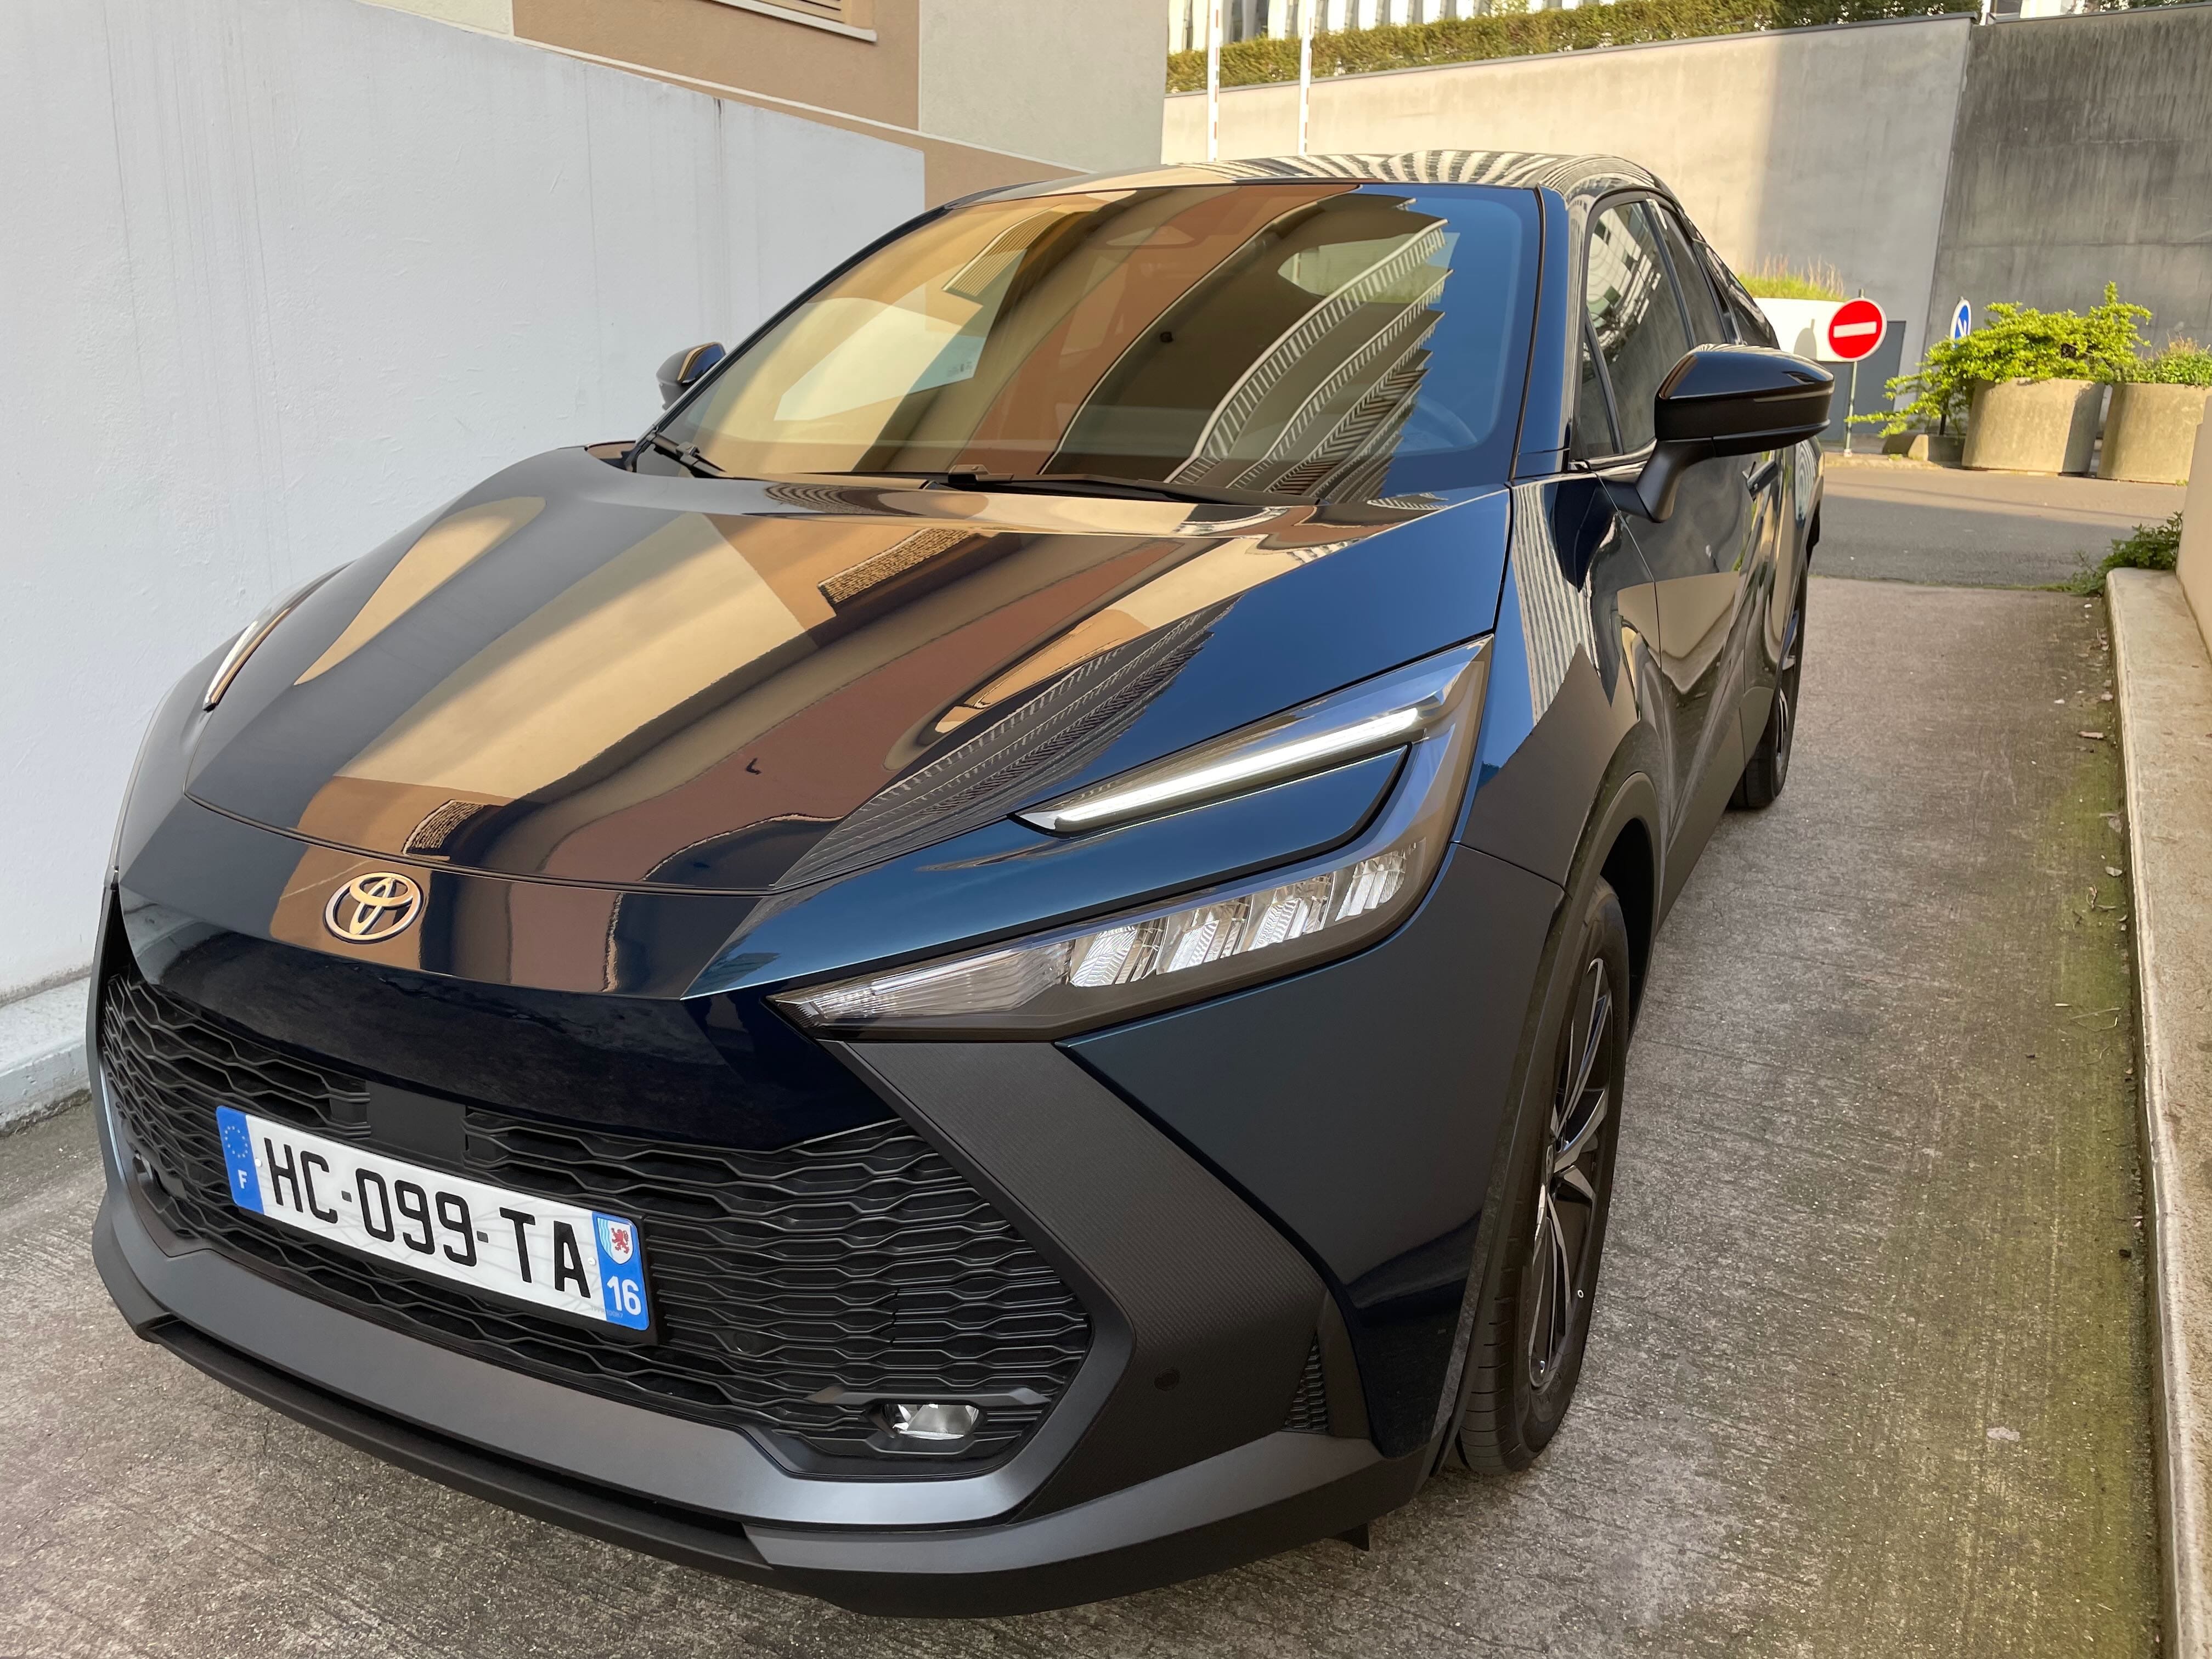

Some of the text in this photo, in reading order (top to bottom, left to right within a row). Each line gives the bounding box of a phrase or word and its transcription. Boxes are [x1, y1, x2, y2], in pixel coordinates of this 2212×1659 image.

[238, 1169, 247, 1189] F
[264, 1137, 591, 1299] HC-099-TA
[607, 1276, 642, 1316] 16
